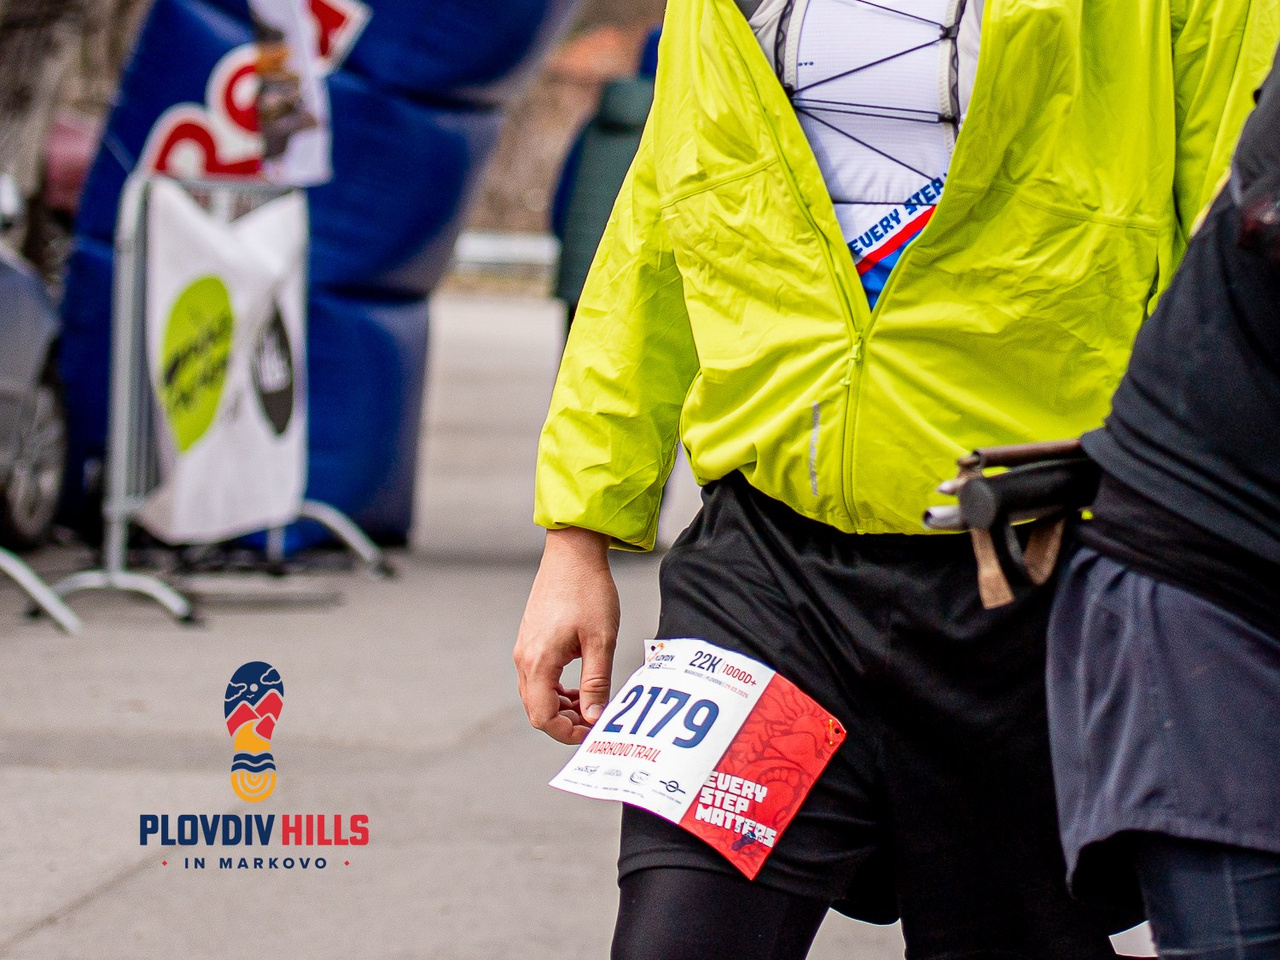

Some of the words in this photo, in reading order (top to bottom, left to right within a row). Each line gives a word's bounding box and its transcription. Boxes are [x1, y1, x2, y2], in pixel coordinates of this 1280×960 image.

[847, 208, 902, 256] EVERY
[689, 650, 723, 673] 22K
[602, 684, 720, 749] 2179
[586, 740, 634, 757] MARKOVO
[630, 744, 661, 763] TRAIL
[698, 786, 750, 814] STEP
[705, 770, 768, 804] EVERY
[694, 803, 777, 848] MATTERS
